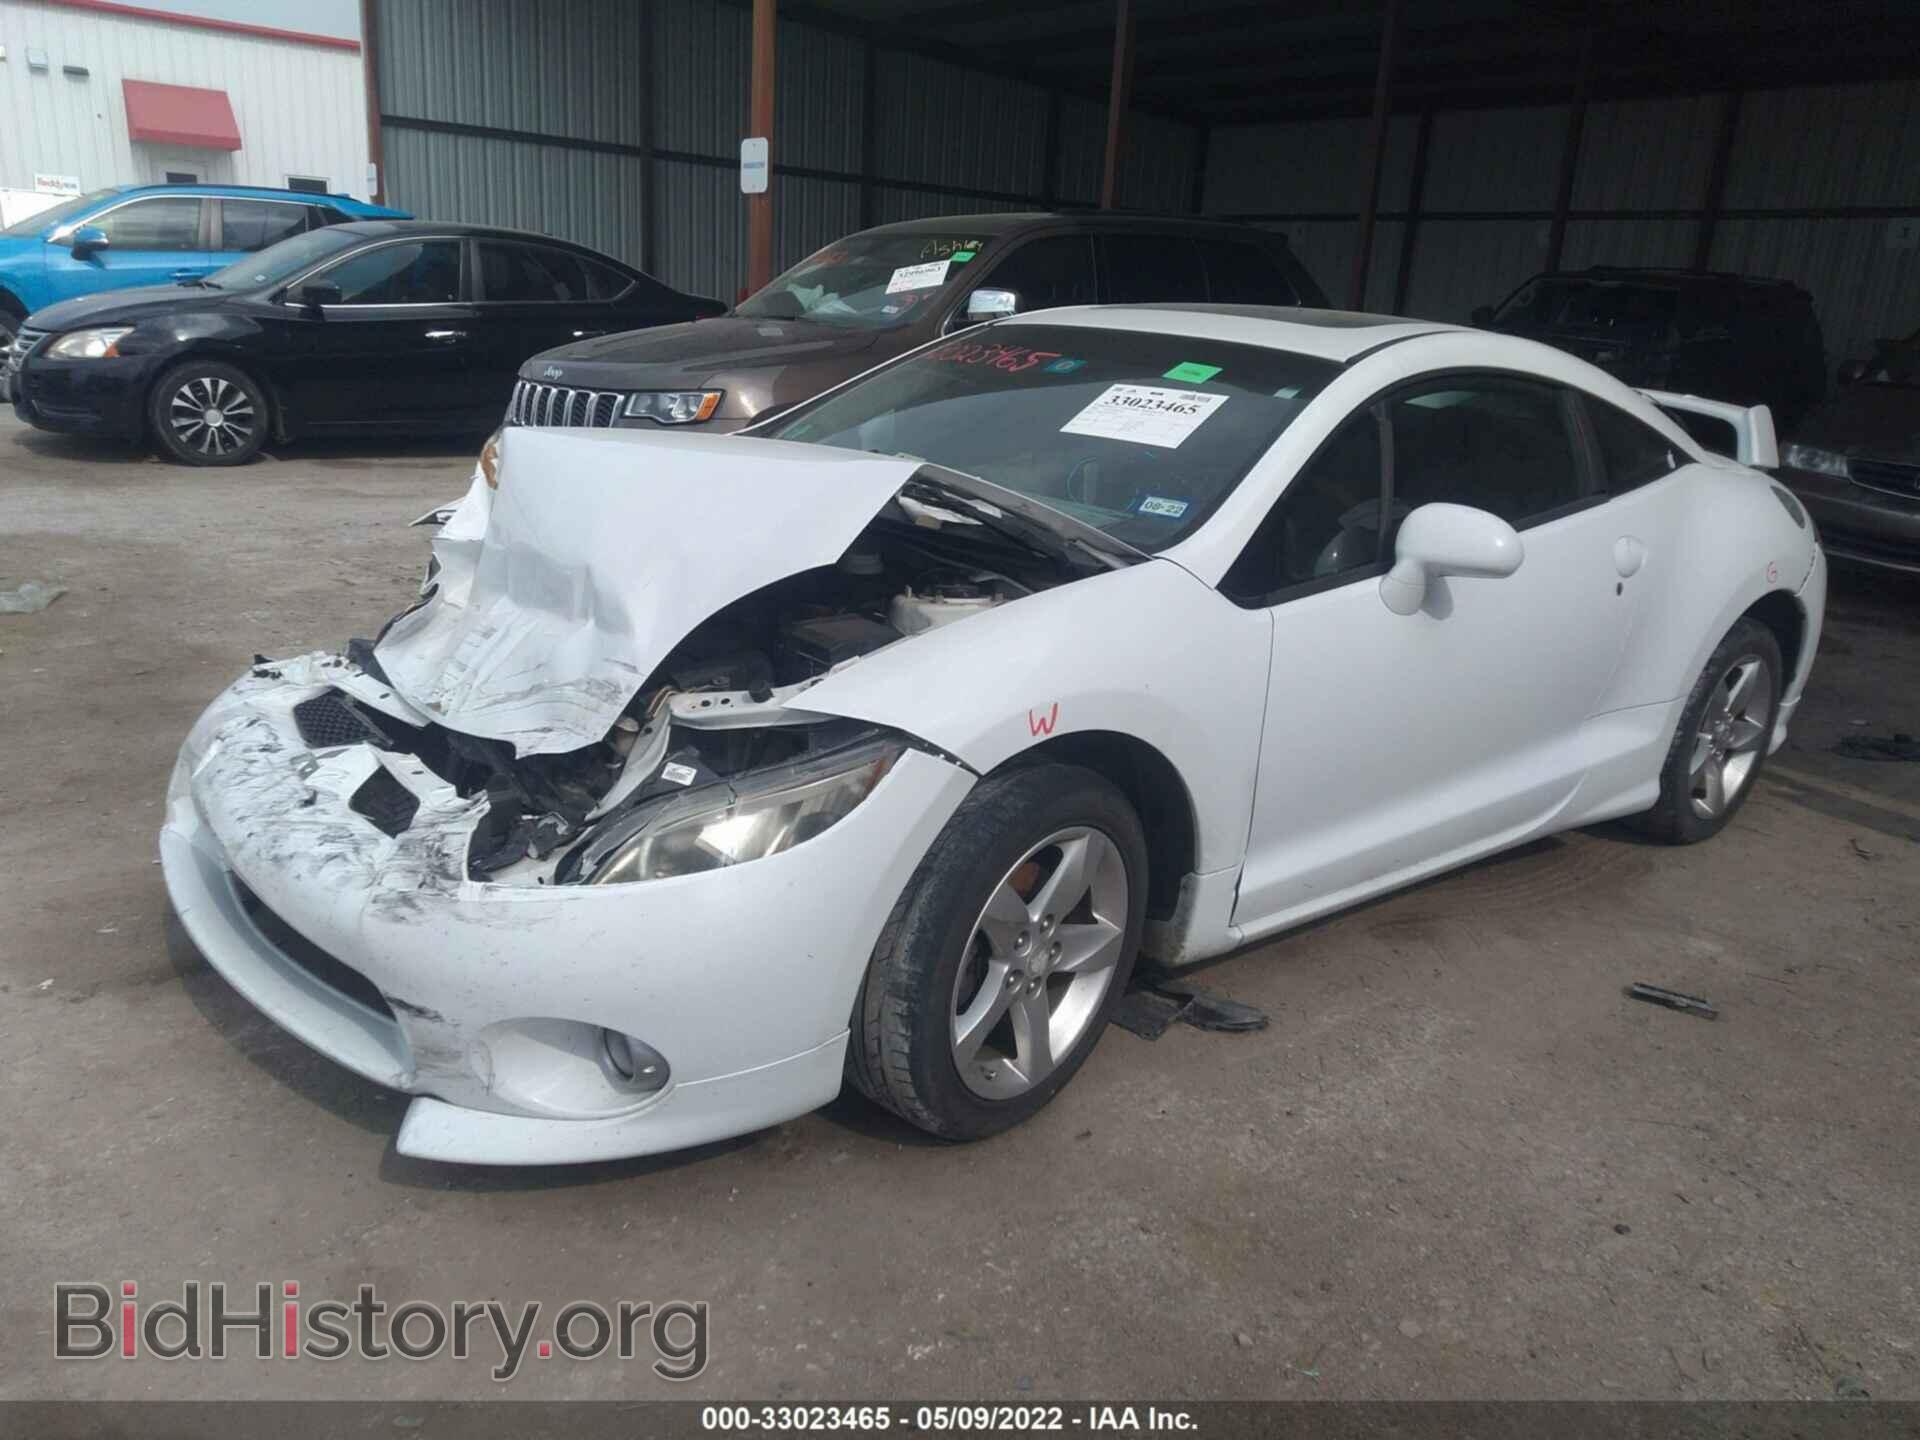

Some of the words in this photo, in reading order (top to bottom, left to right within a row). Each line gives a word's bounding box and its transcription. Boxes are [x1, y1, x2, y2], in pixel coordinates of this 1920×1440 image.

[1104, 394, 1200, 415] 33023465
[1143, 500, 1184, 514] 08-22
[1028, 702, 1058, 737] W
